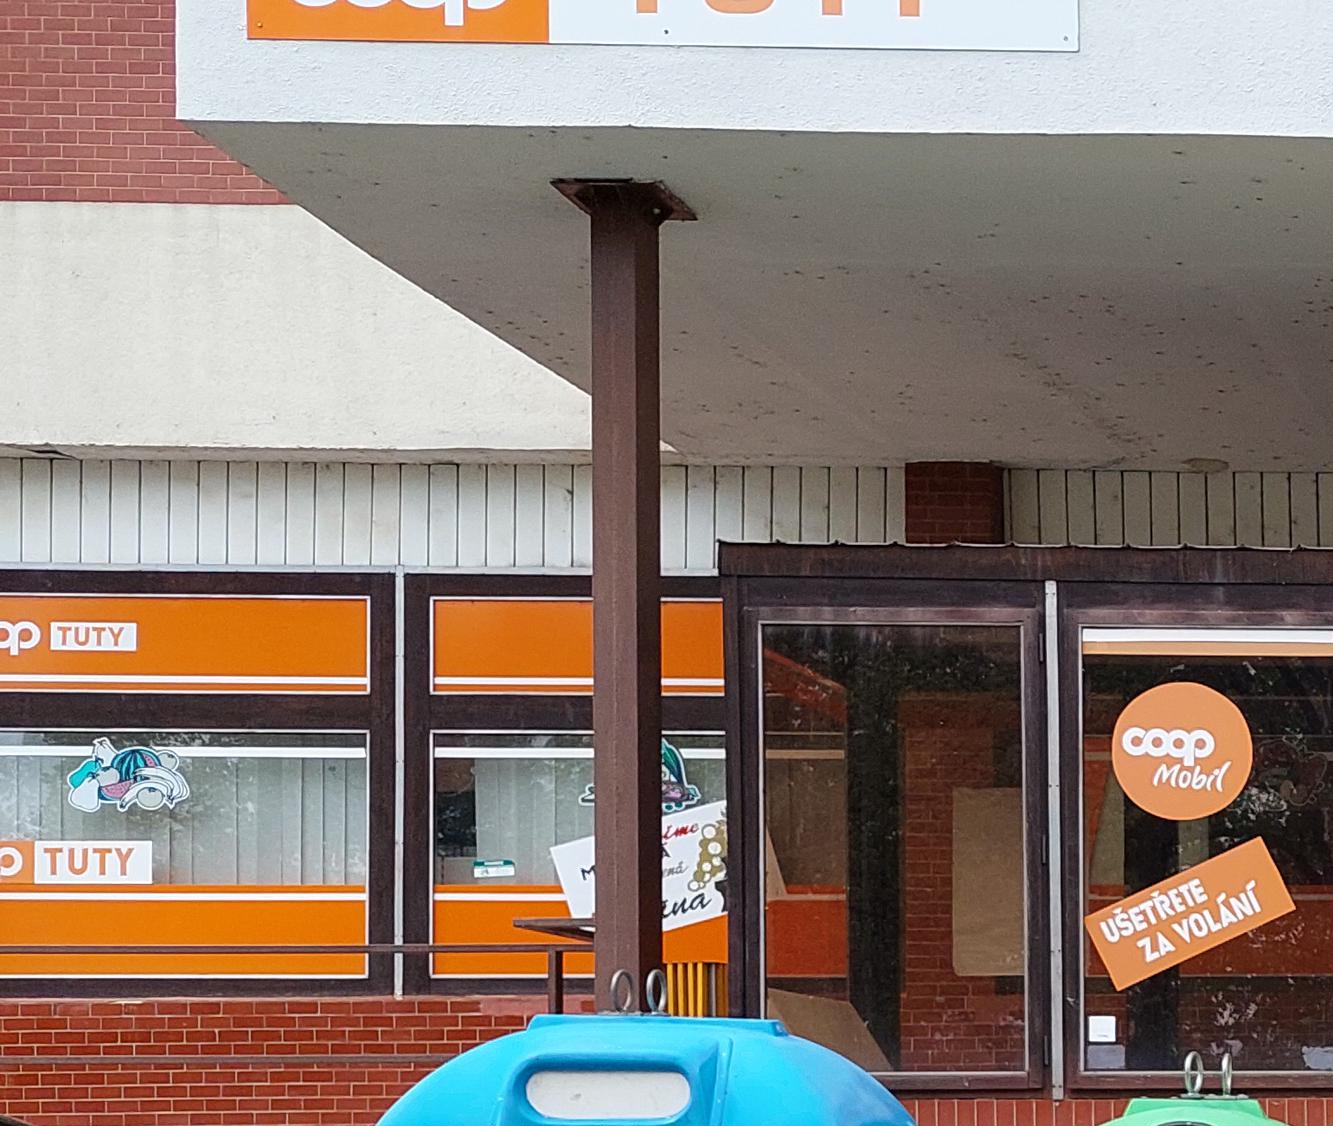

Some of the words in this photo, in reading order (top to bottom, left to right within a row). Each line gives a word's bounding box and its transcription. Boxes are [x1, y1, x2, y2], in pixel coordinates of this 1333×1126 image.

[57, 626, 124, 646] TUTY
[1122, 727, 1216, 767] coop
[1152, 761, 1232, 793] Mobil
[44, 847, 135, 877] TUTY
[1099, 878, 1209, 944] UŠETŘETE
[1136, 931, 1176, 963] ZA
[1171, 879, 1262, 945] VOLÁNÍ
